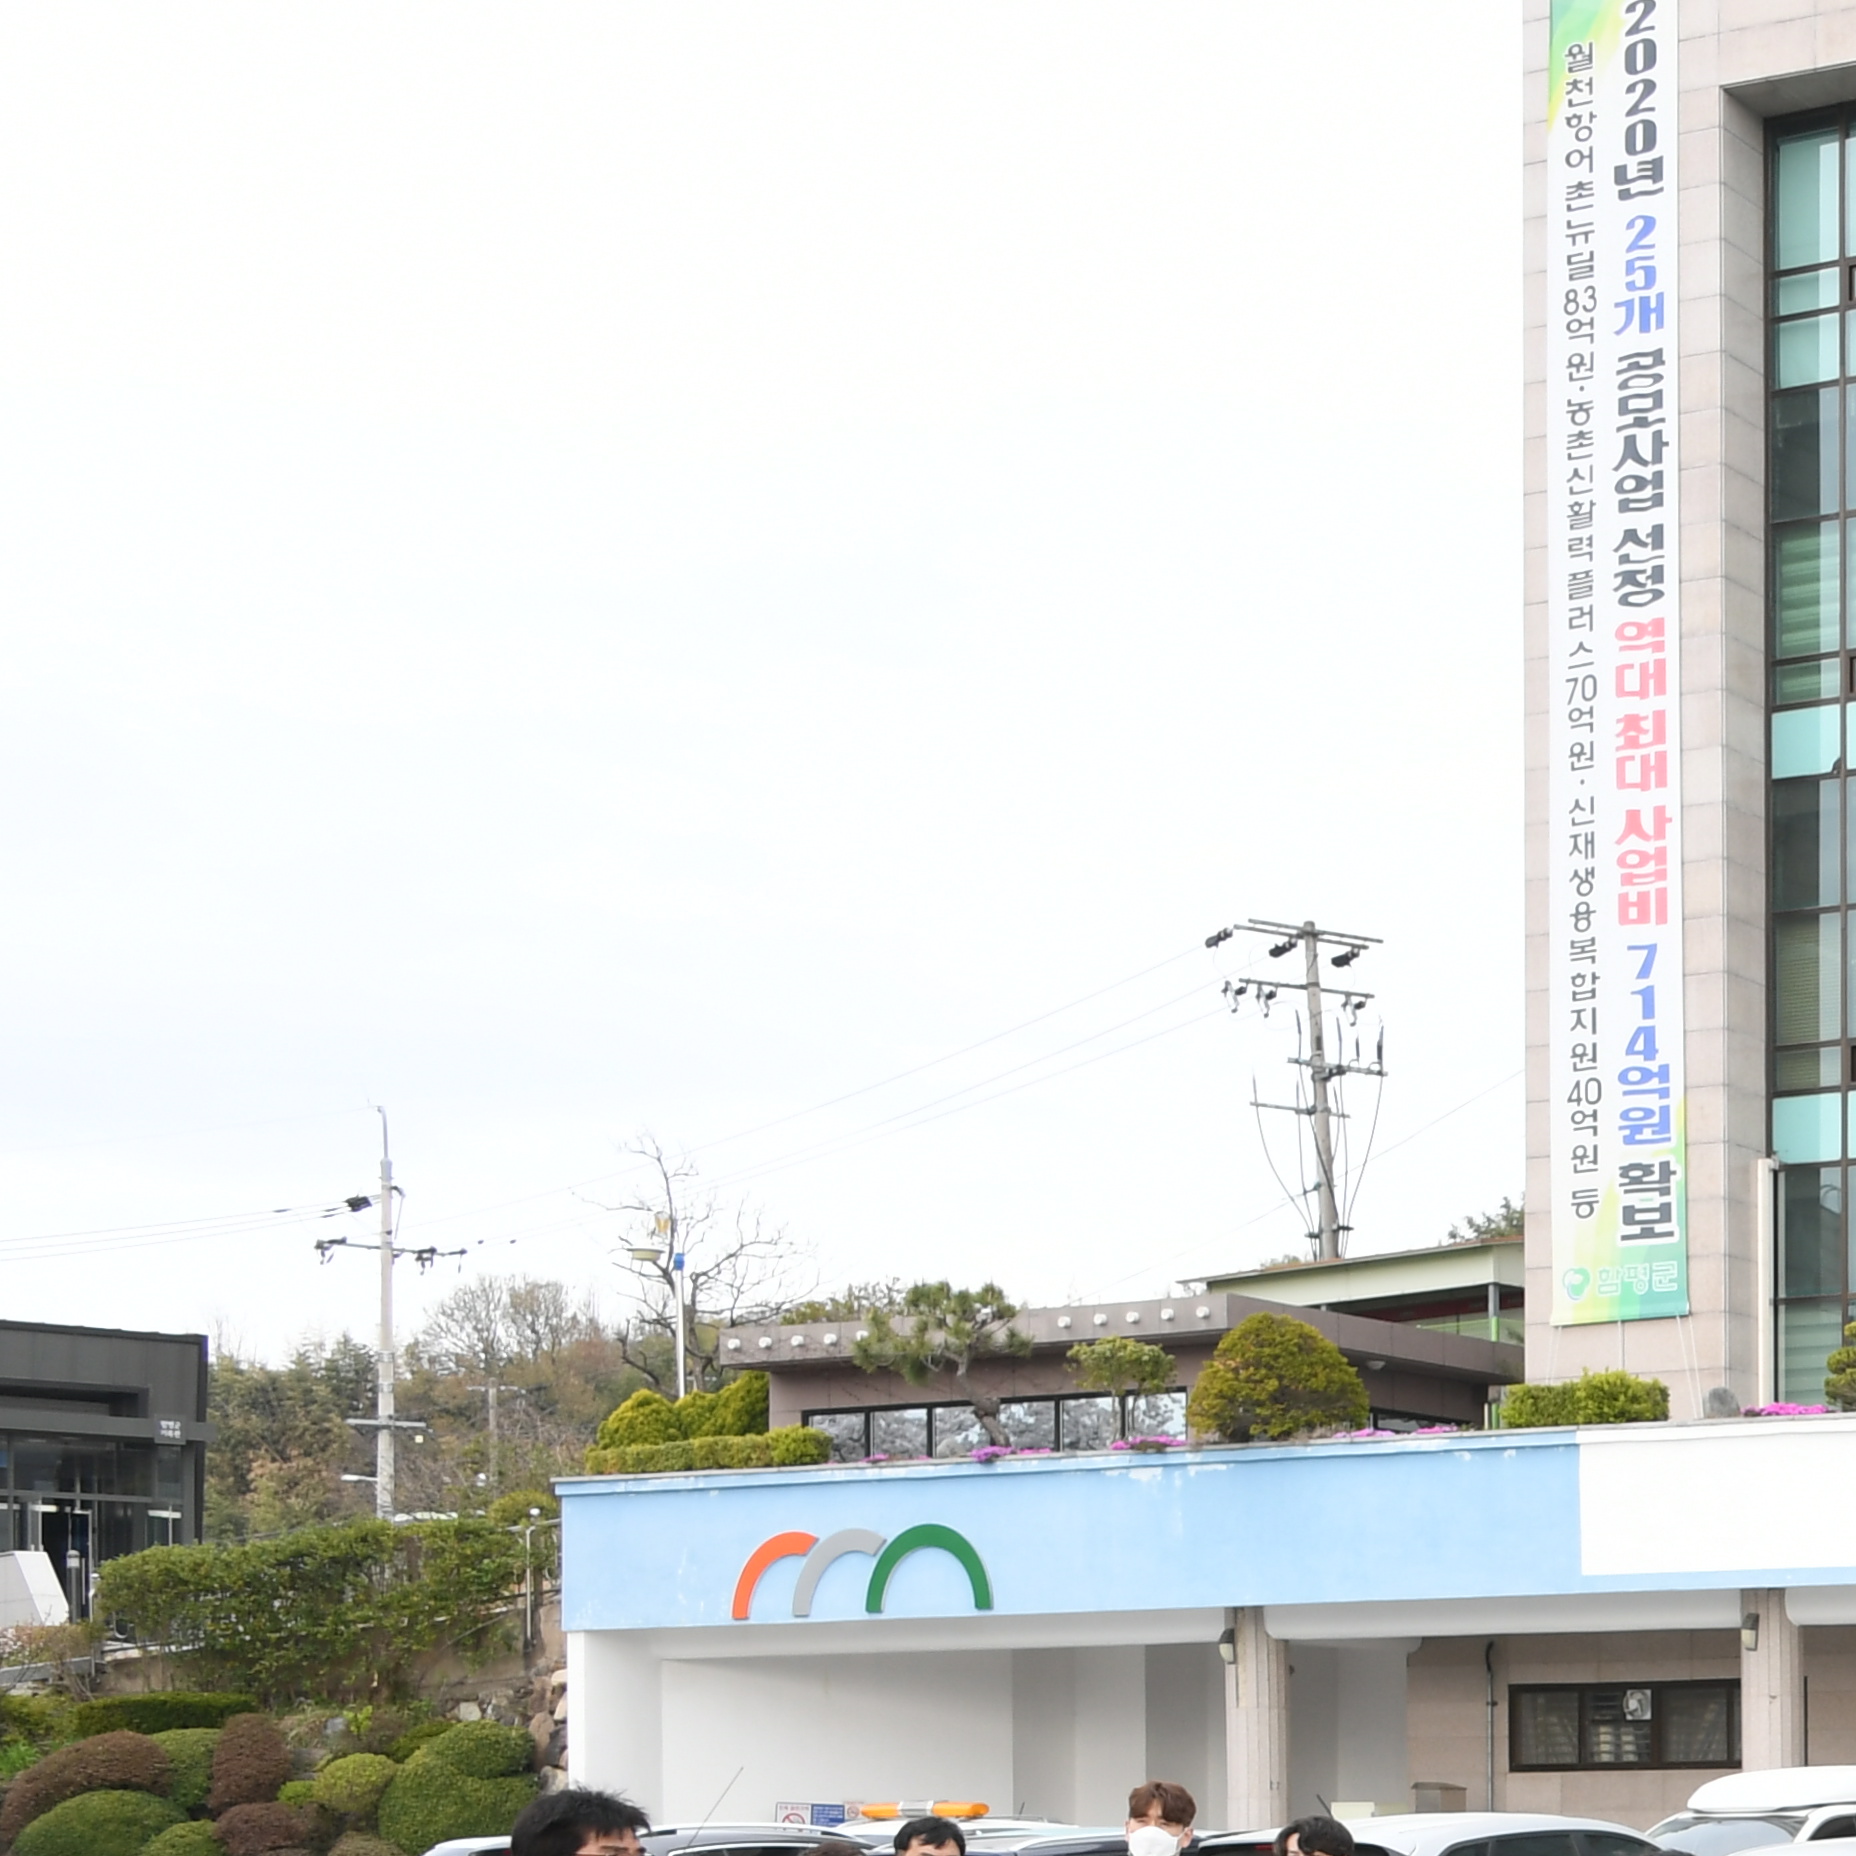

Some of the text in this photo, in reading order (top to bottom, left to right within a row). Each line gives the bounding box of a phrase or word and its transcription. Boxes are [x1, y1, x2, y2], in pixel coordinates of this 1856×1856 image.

[1612, 0, 1677, 1243] 2020년 25개 공모사업 선정 역대 최대 사업비 714억원 확보
[1570, 1188, 1600, 1219] 등
[1598, 1261, 1677, 1296] 함평군
